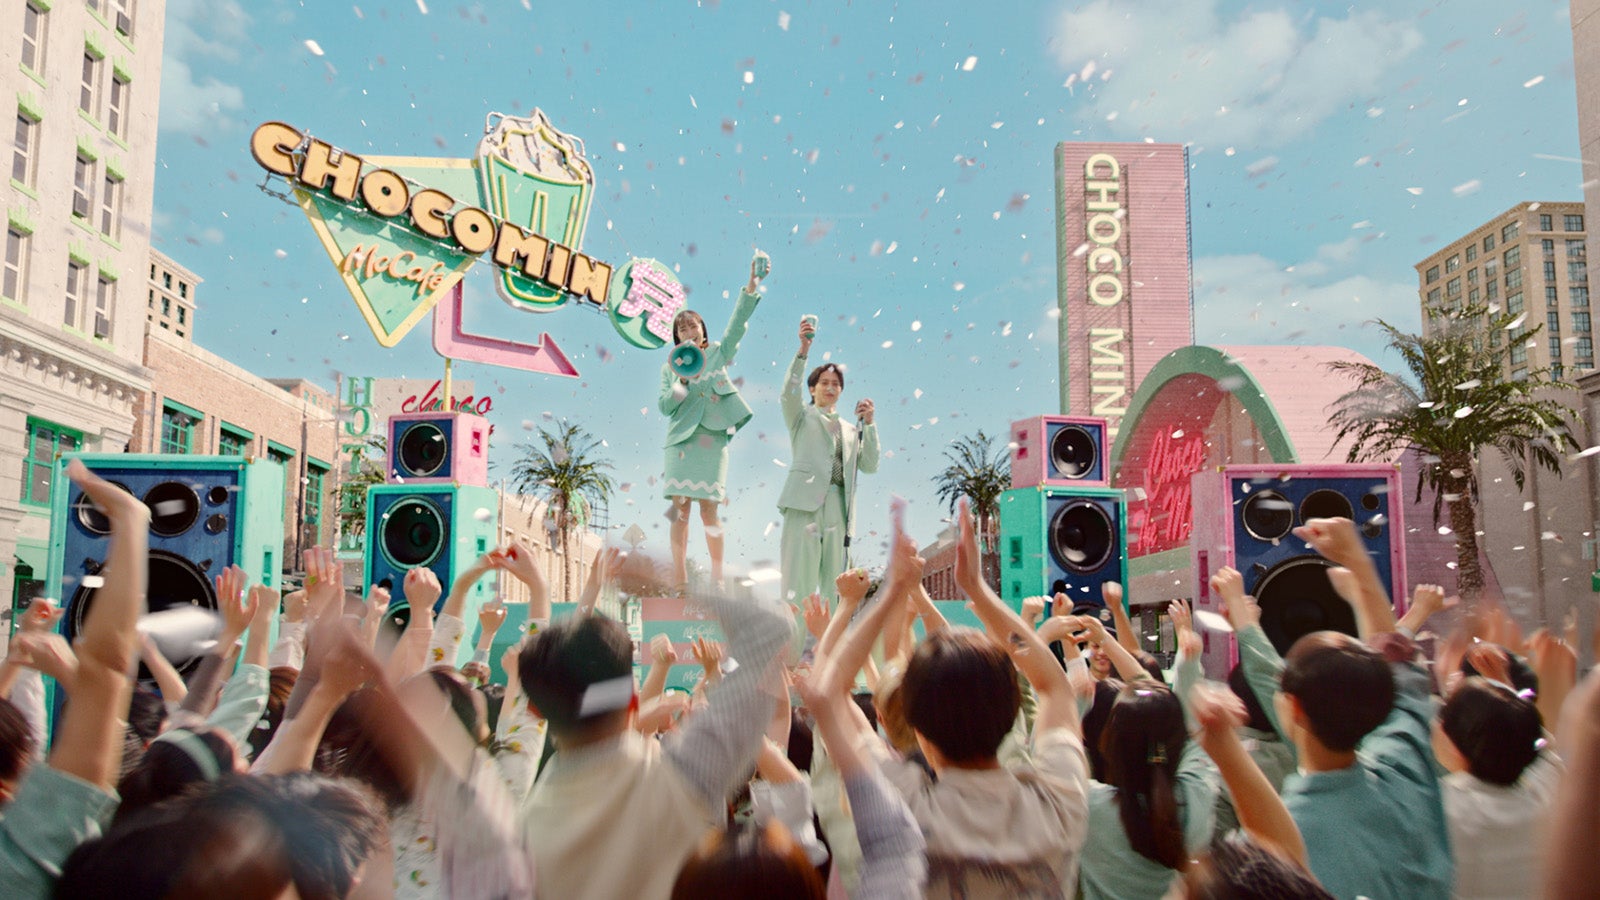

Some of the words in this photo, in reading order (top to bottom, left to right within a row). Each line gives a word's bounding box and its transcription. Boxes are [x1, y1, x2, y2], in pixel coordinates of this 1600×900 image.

[250, 122, 614, 305] CHOCOMIN
[343, 244, 446, 296] McCafé
[1085, 153, 1123, 307] CHOCO
[1090, 328, 1127, 435] MIN
